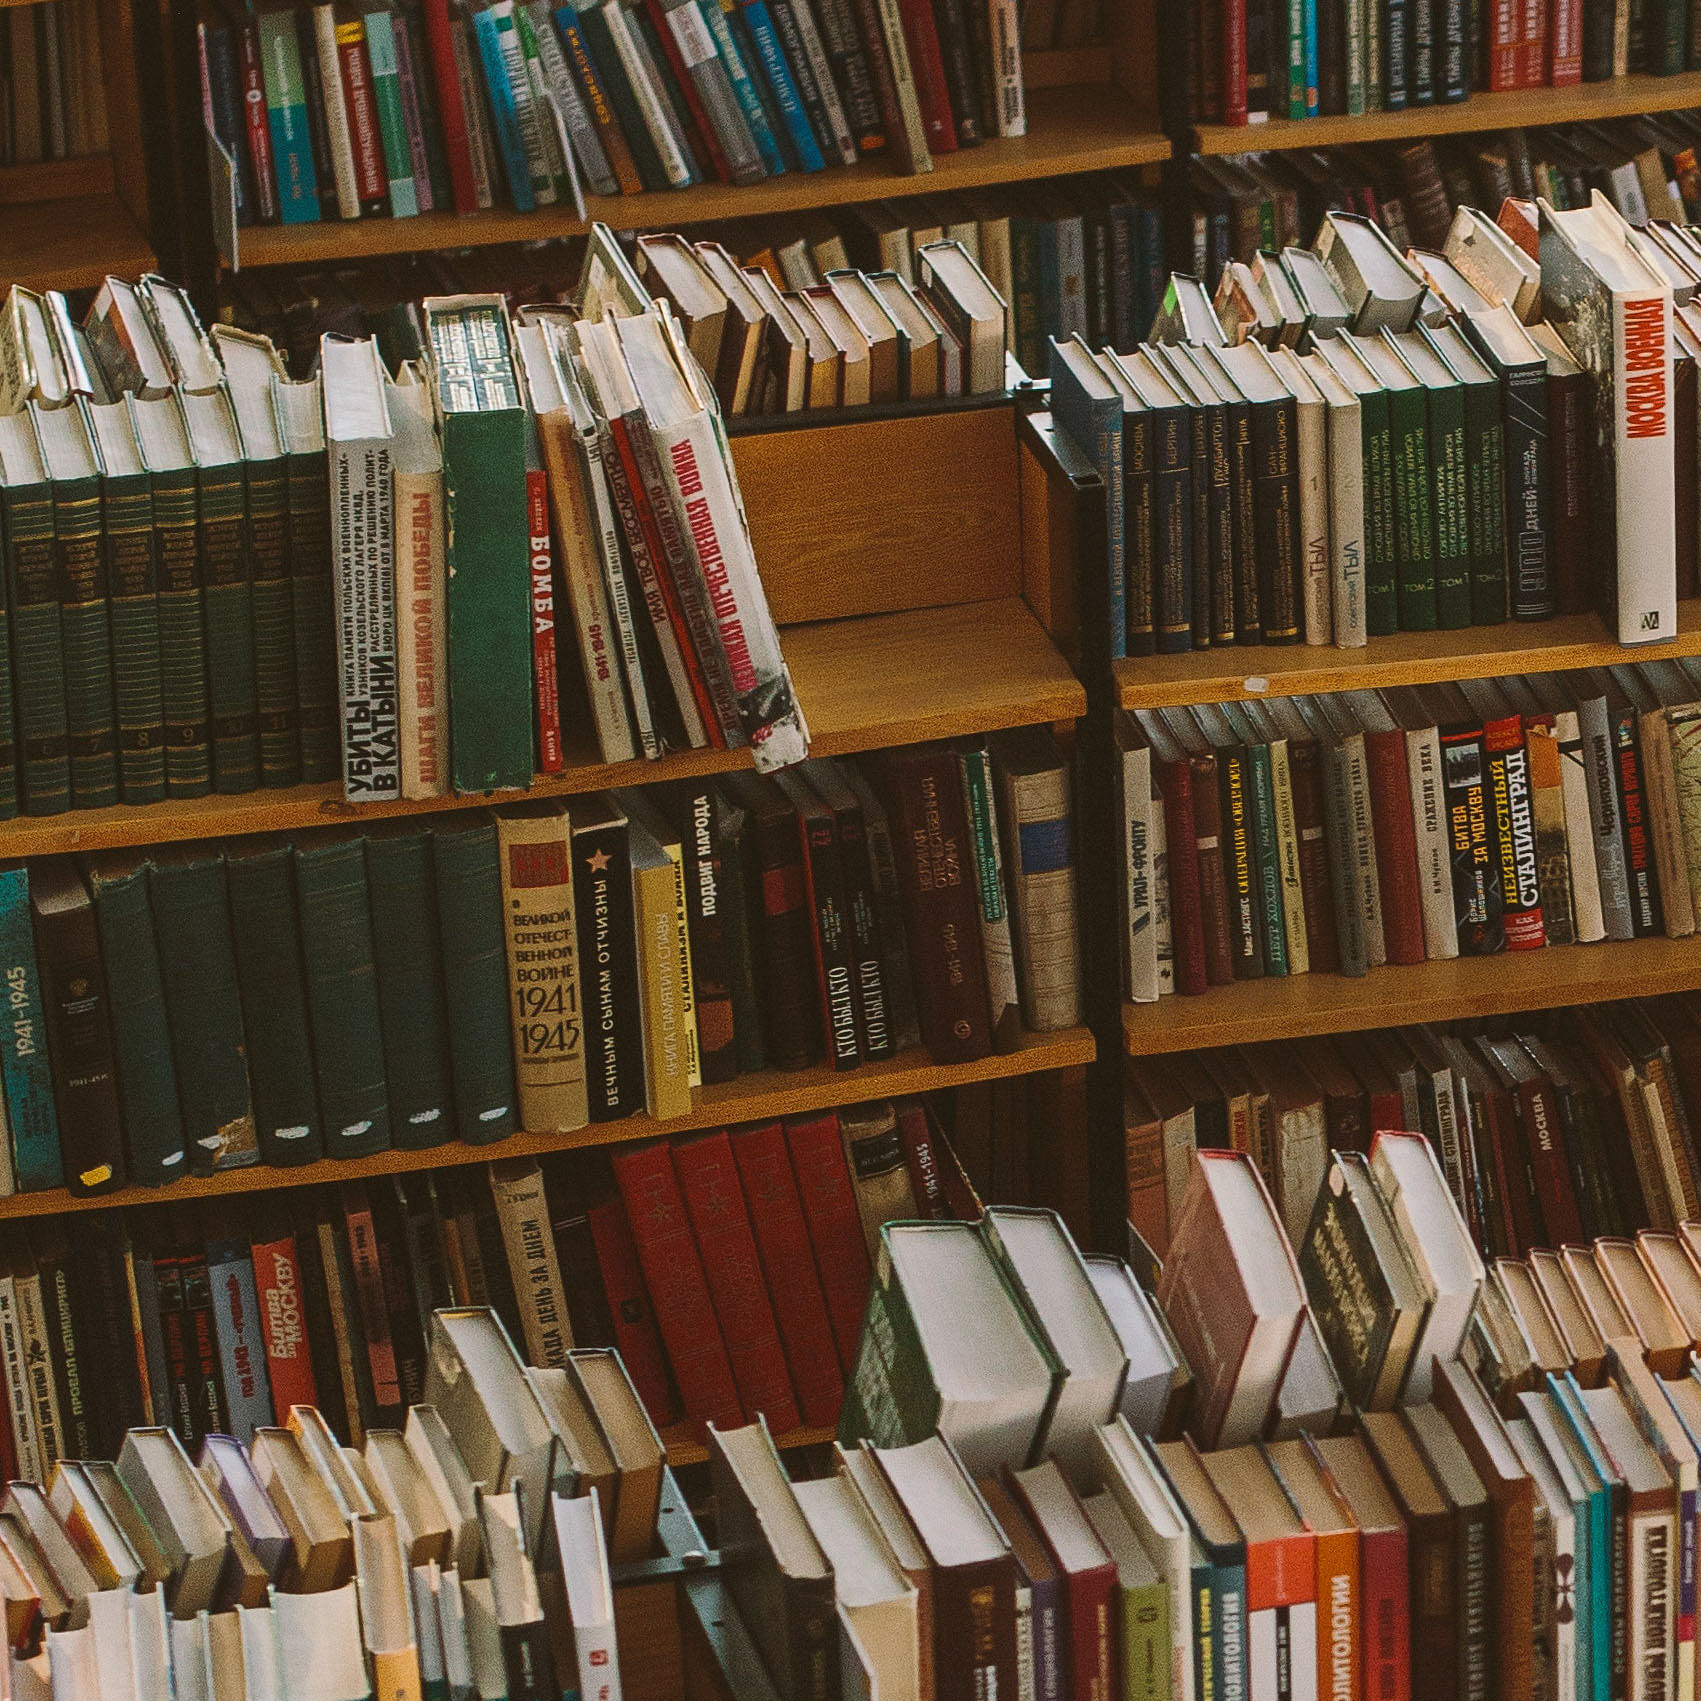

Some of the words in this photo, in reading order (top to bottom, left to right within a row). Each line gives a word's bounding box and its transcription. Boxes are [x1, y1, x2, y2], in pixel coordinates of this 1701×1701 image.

[1624, 298, 1664, 371] ВОЕННАЯ
[1626, 374, 1666, 438] МОСКВА
[669, 438, 702, 495] ВОЙНА
[605, 452, 643, 544] БЕССМЕРТНО
[412, 493, 431, 591] ПОБЕДЫ
[636, 549, 658, 586] ТВОЕ
[680, 500, 733, 620] ОТЕЧЕСТВЕННАЯ
[341, 557, 352, 613] ПОЛЬСКИХ
[530, 536, 554, 633] БОМБА
[649, 590, 666, 623] ИМЯ
[342, 616, 354, 660] ПАМЯТИ
[413, 599, 435, 707] ВЕЛИКОЙ
[345, 662, 355, 696] КНИГА
[369, 655, 396, 767] КАТЫНИ
[346, 701, 372, 794] УБИТЫ
[417, 715, 437, 782] ШАГИ
[1421, 744, 1433, 771] ВЕКА
[373, 773, 397, 793] В
[1424, 778, 1437, 831] СРАЖЕНИЕ
[1592, 735, 1614, 837] Черняховский
[694, 796, 712, 855] НАРОДА
[1452, 806, 1470, 850] БИТВА
[1468, 786, 1487, 842] МОСКВУ
[1489, 760, 1519, 904] НЕИЗВЕСТНЫЙ
[1505, 749, 1538, 907] СТАЛИНГРАД
[1132, 820, 1148, 909] УРАЛ-ФРОНТУ
[1474, 846, 1488, 864] ЗА
[700, 860, 716, 916] ПОДВИГ
[593, 880, 611, 963] ОТЧИЗНЫ
[515, 982, 578, 1017] 1941
[598, 970, 614, 1030] СЫНАМ
[829, 967, 851, 994] КТО
[519, 1018, 578, 1053] 1945
[835, 1029, 857, 1057] КТО
[603, 1037, 619, 1106] ВЕЧНЫМ
[520, 1220, 545, 1261] ДНЕМ
[269, 1252, 304, 1342] МОСКВУ
[530, 1264, 550, 1283] ЗА
[264, 1288, 288, 1358] Битва
[532, 1288, 559, 1324] ДЕНЬ
